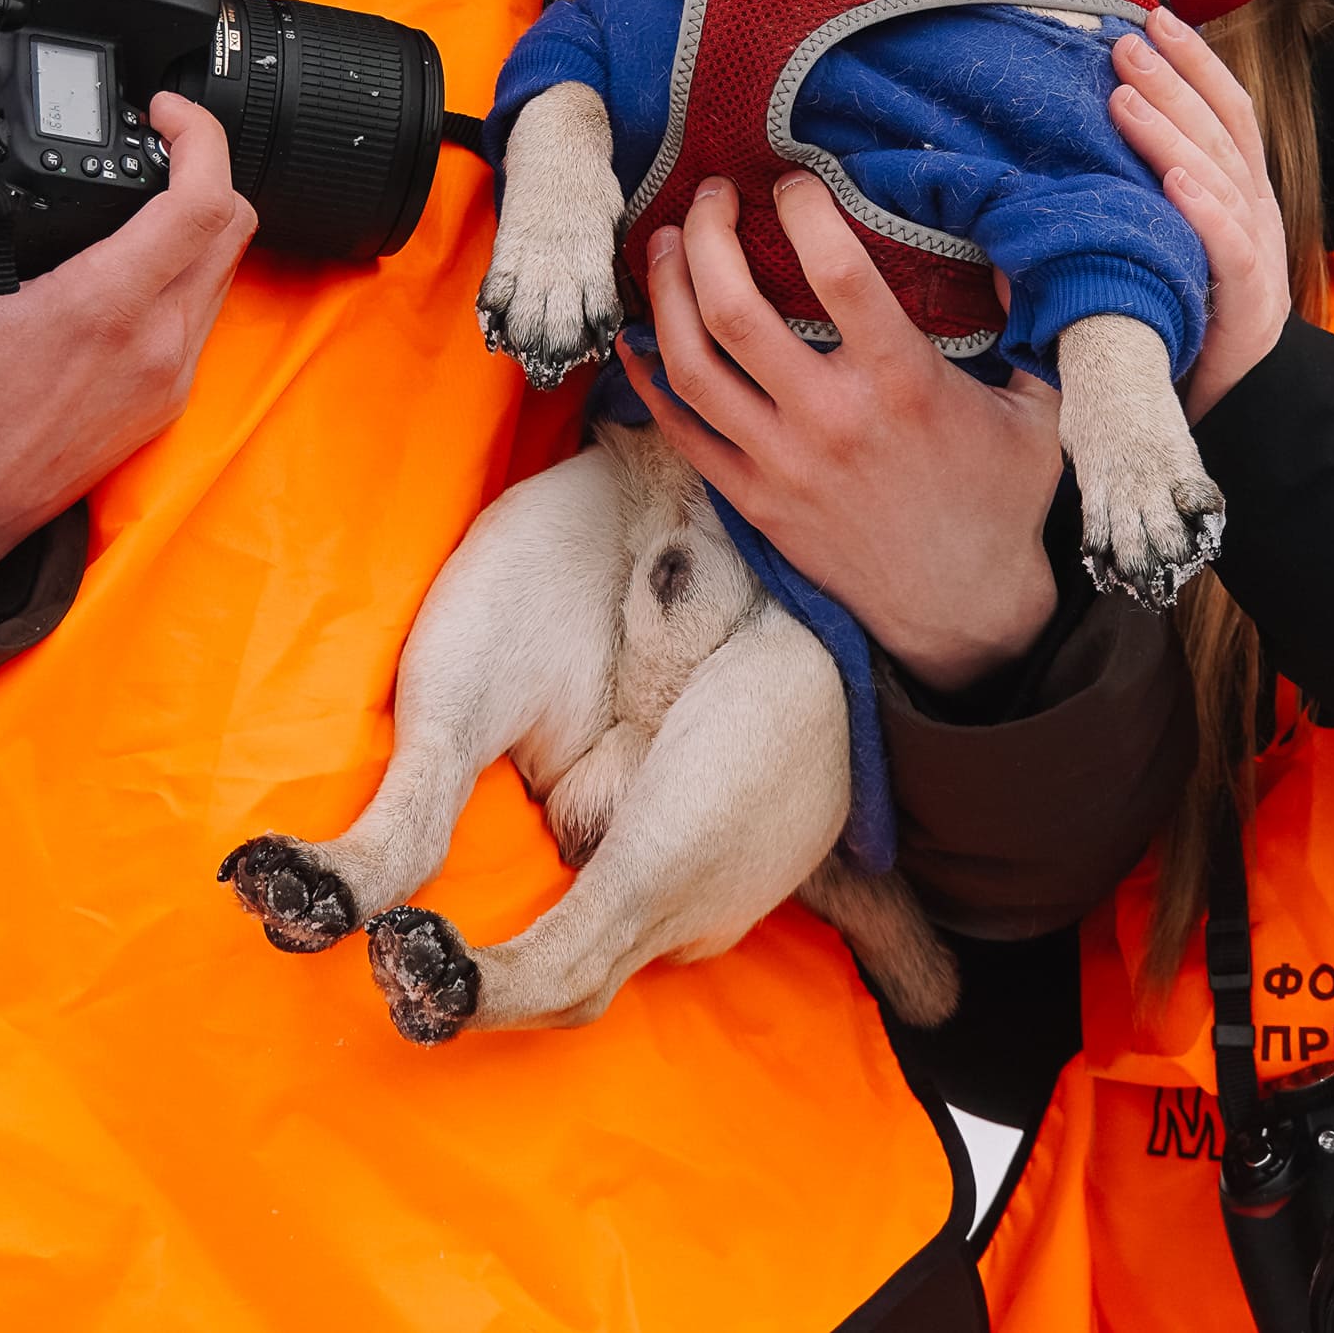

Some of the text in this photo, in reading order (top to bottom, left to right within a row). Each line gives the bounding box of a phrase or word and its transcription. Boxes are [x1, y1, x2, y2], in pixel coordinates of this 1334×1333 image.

[285, 30, 296, 40] 18
[147, 136, 156, 151] OFF
[47, 152, 59, 167] AF
[152, 152, 163, 164] ON
